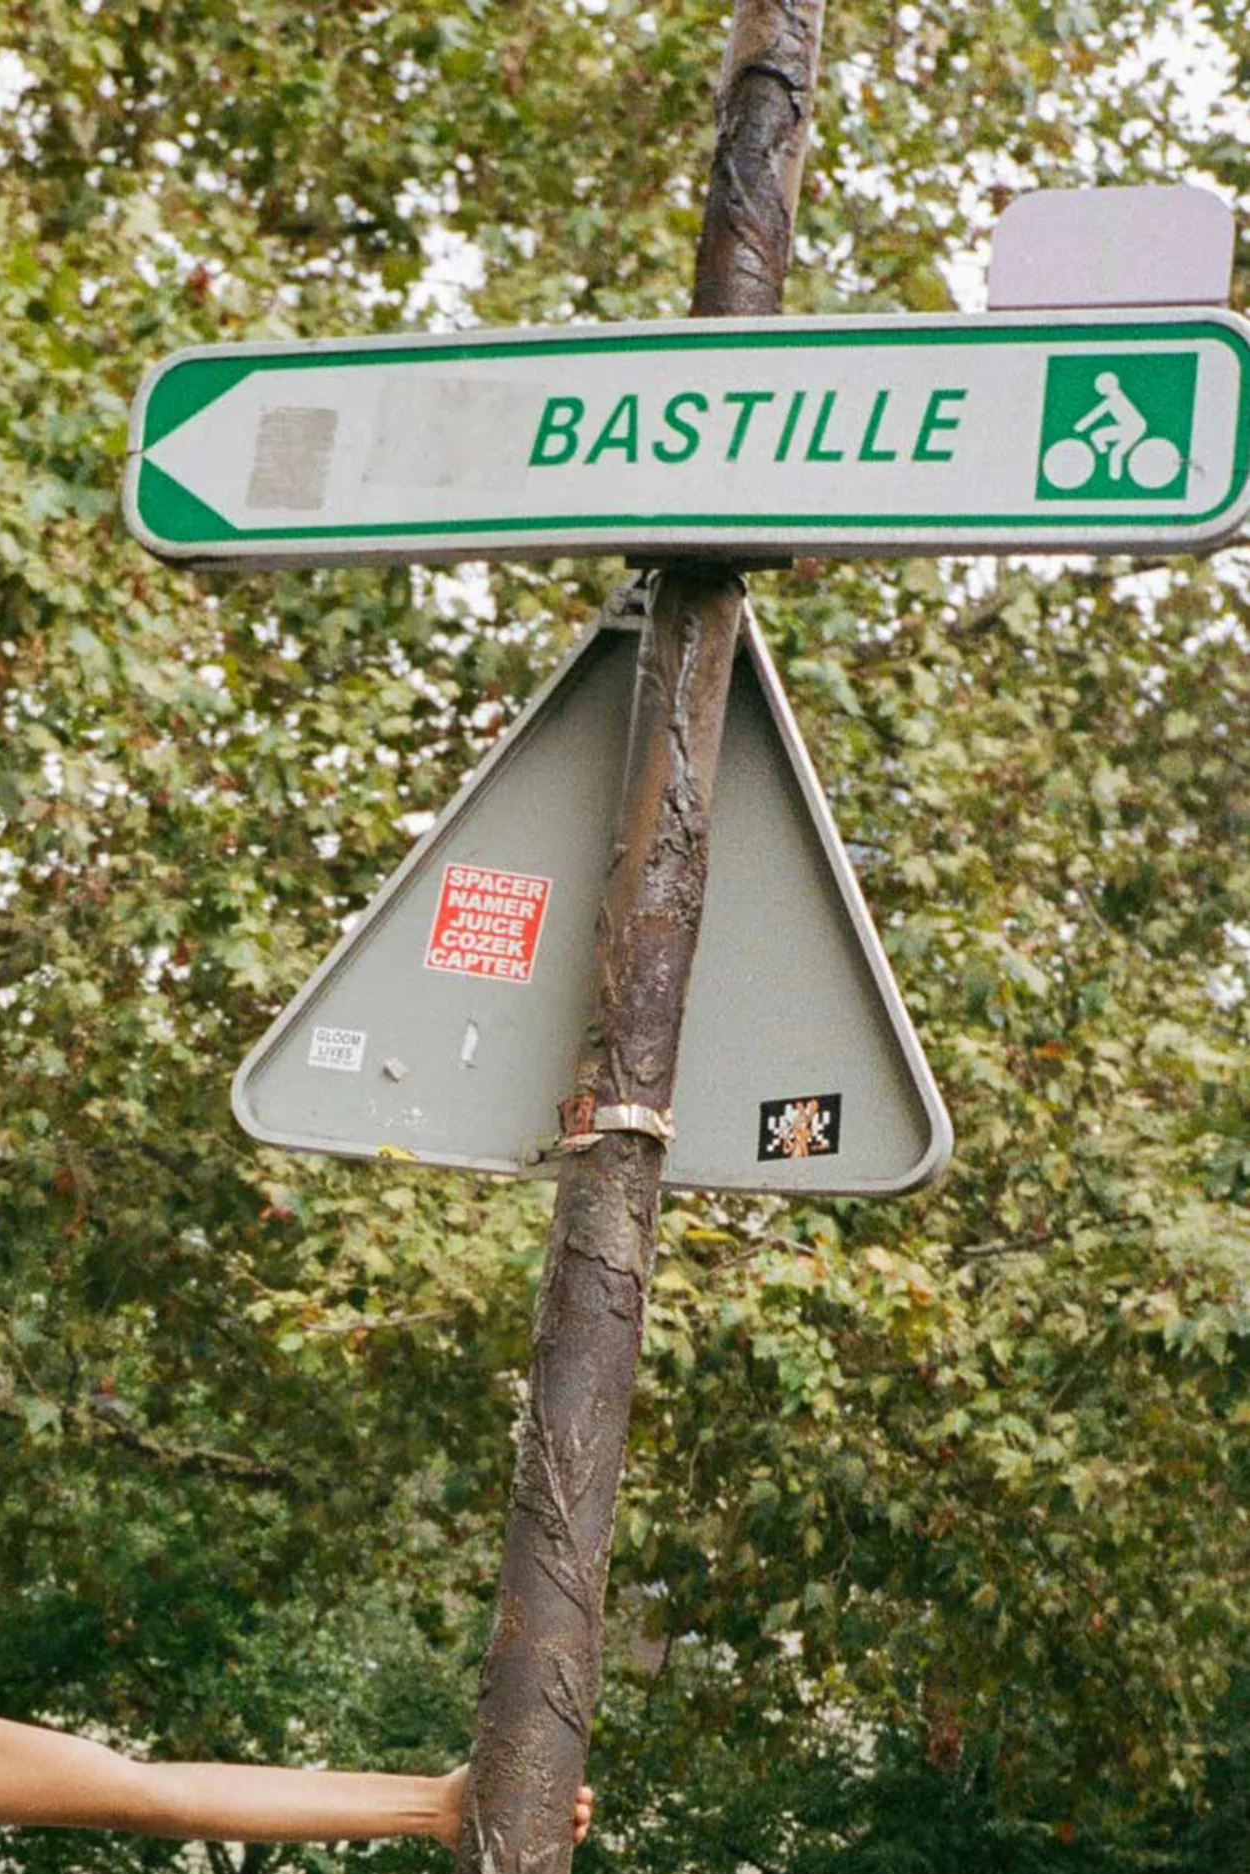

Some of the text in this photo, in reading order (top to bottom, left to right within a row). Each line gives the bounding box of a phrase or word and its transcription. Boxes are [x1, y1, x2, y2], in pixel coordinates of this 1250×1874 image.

[528, 387, 968, 467] BASTILLE
[448, 868, 544, 900] SPACER
[447, 889, 537, 920] NAMER
[449, 911, 526, 938] JUICE
[440, 929, 526, 958] COZEK
[430, 947, 530, 978] CAPTEK
